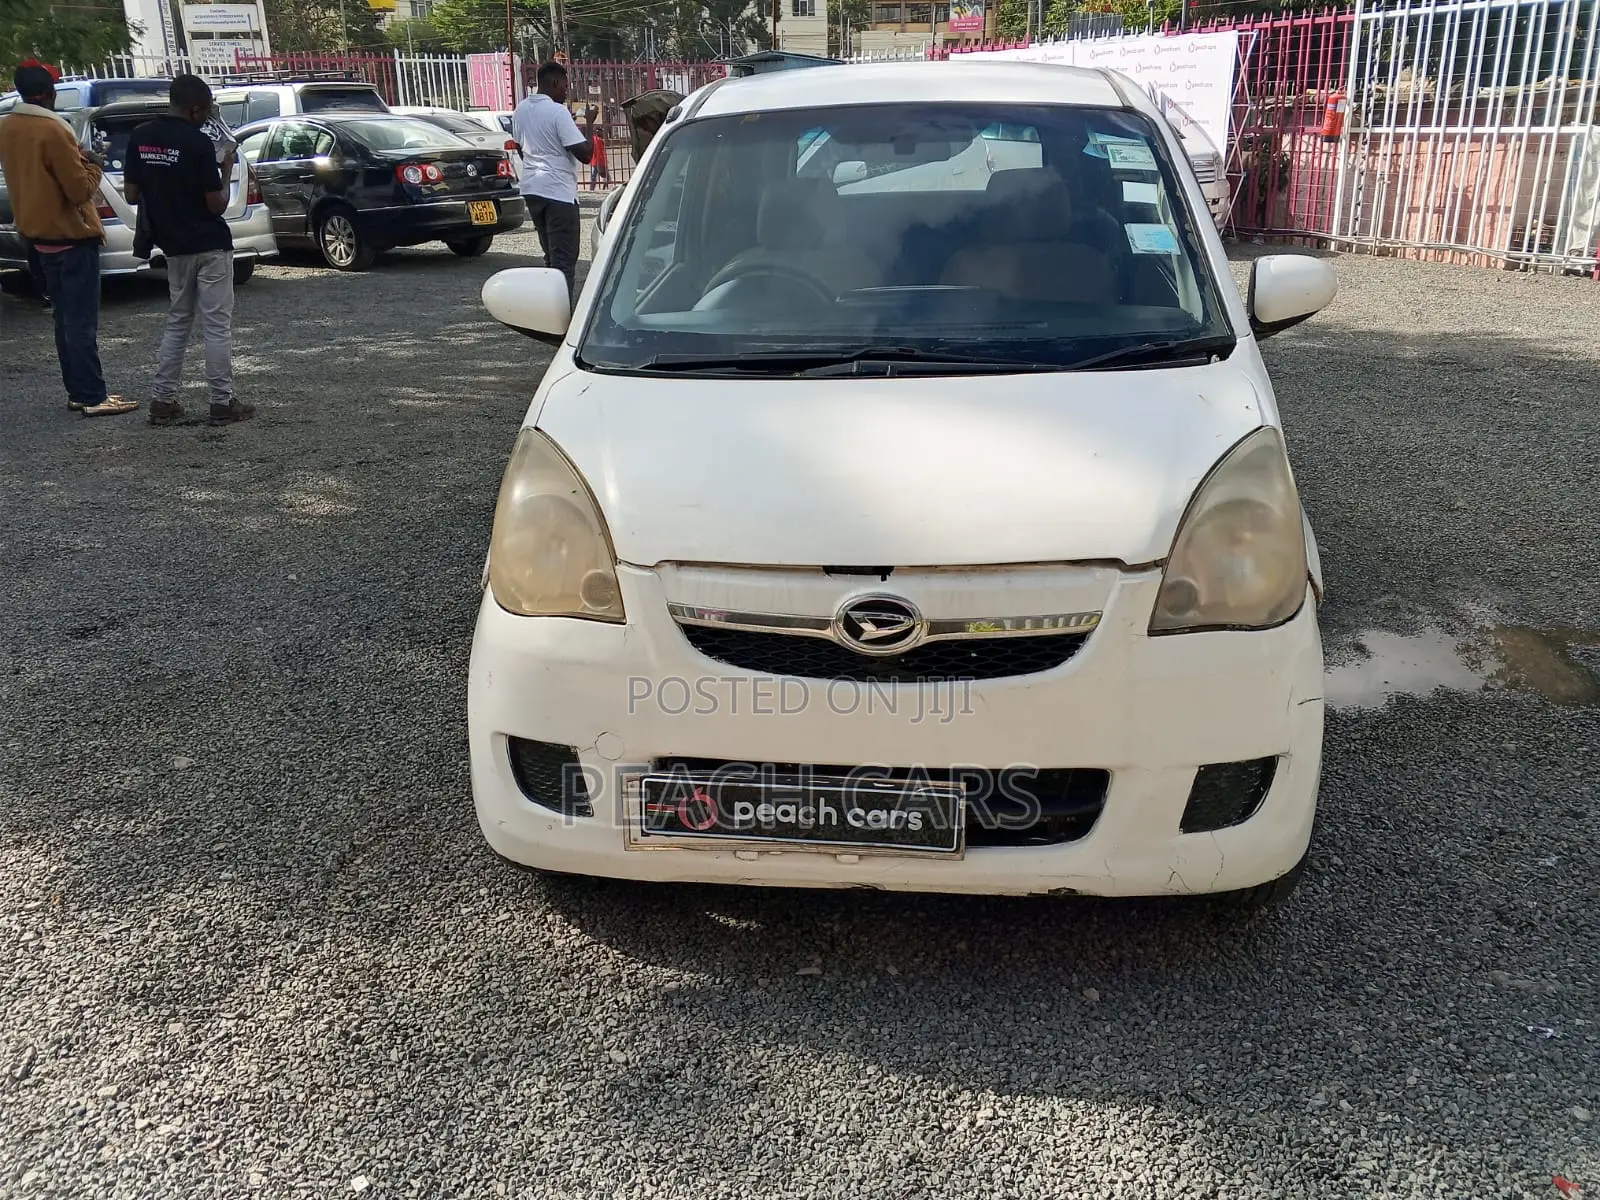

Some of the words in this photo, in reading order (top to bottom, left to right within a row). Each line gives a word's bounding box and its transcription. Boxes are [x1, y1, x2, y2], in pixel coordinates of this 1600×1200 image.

[167, 148, 180, 156] CAR
[140, 153, 178, 162] MARKETPLACE
[474, 211, 495, 221] 481D
[732, 797, 838, 830] peach
[847, 806, 924, 832] cars
